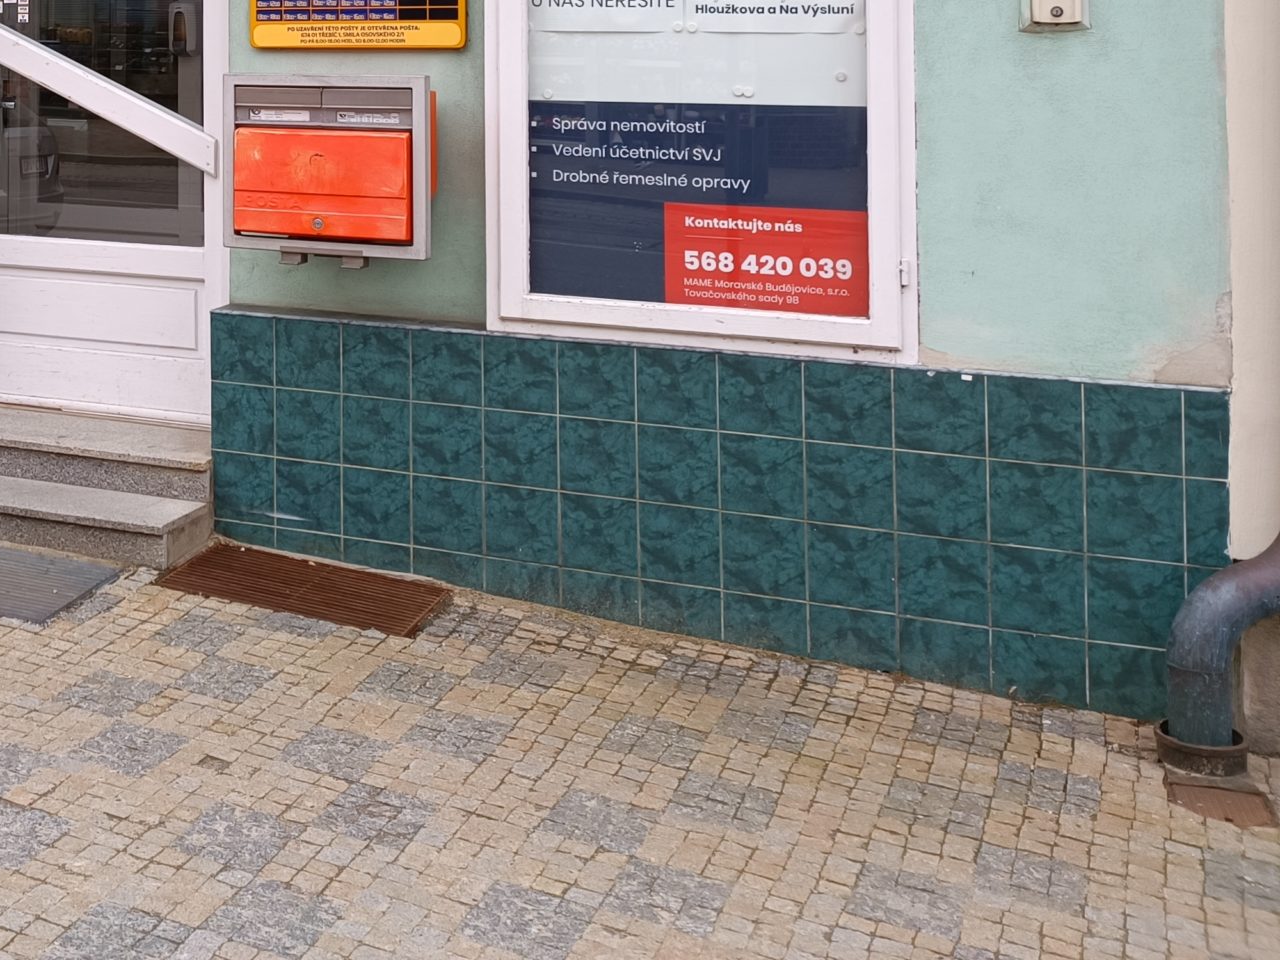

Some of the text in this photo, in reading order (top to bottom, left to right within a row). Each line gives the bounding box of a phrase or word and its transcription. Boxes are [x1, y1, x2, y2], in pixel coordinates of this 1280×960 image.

[695, 3, 855, 18] Hloužkova a Na Výsluní
[552, 117, 706, 134] Správa nemovitostí
[552, 143, 721, 161] Vedení účetnictví SVJ
[552, 169, 750, 193] Drobné řemeslné opravy
[684, 216, 803, 233] Kontaktujte nás
[683, 249, 853, 281] 568 420 039
[684, 277, 850, 297] MAME Moravské Budějovice, s.r.o.
[684, 288, 757, 302] Tovačovského
[758, 295, 784, 305] sady
